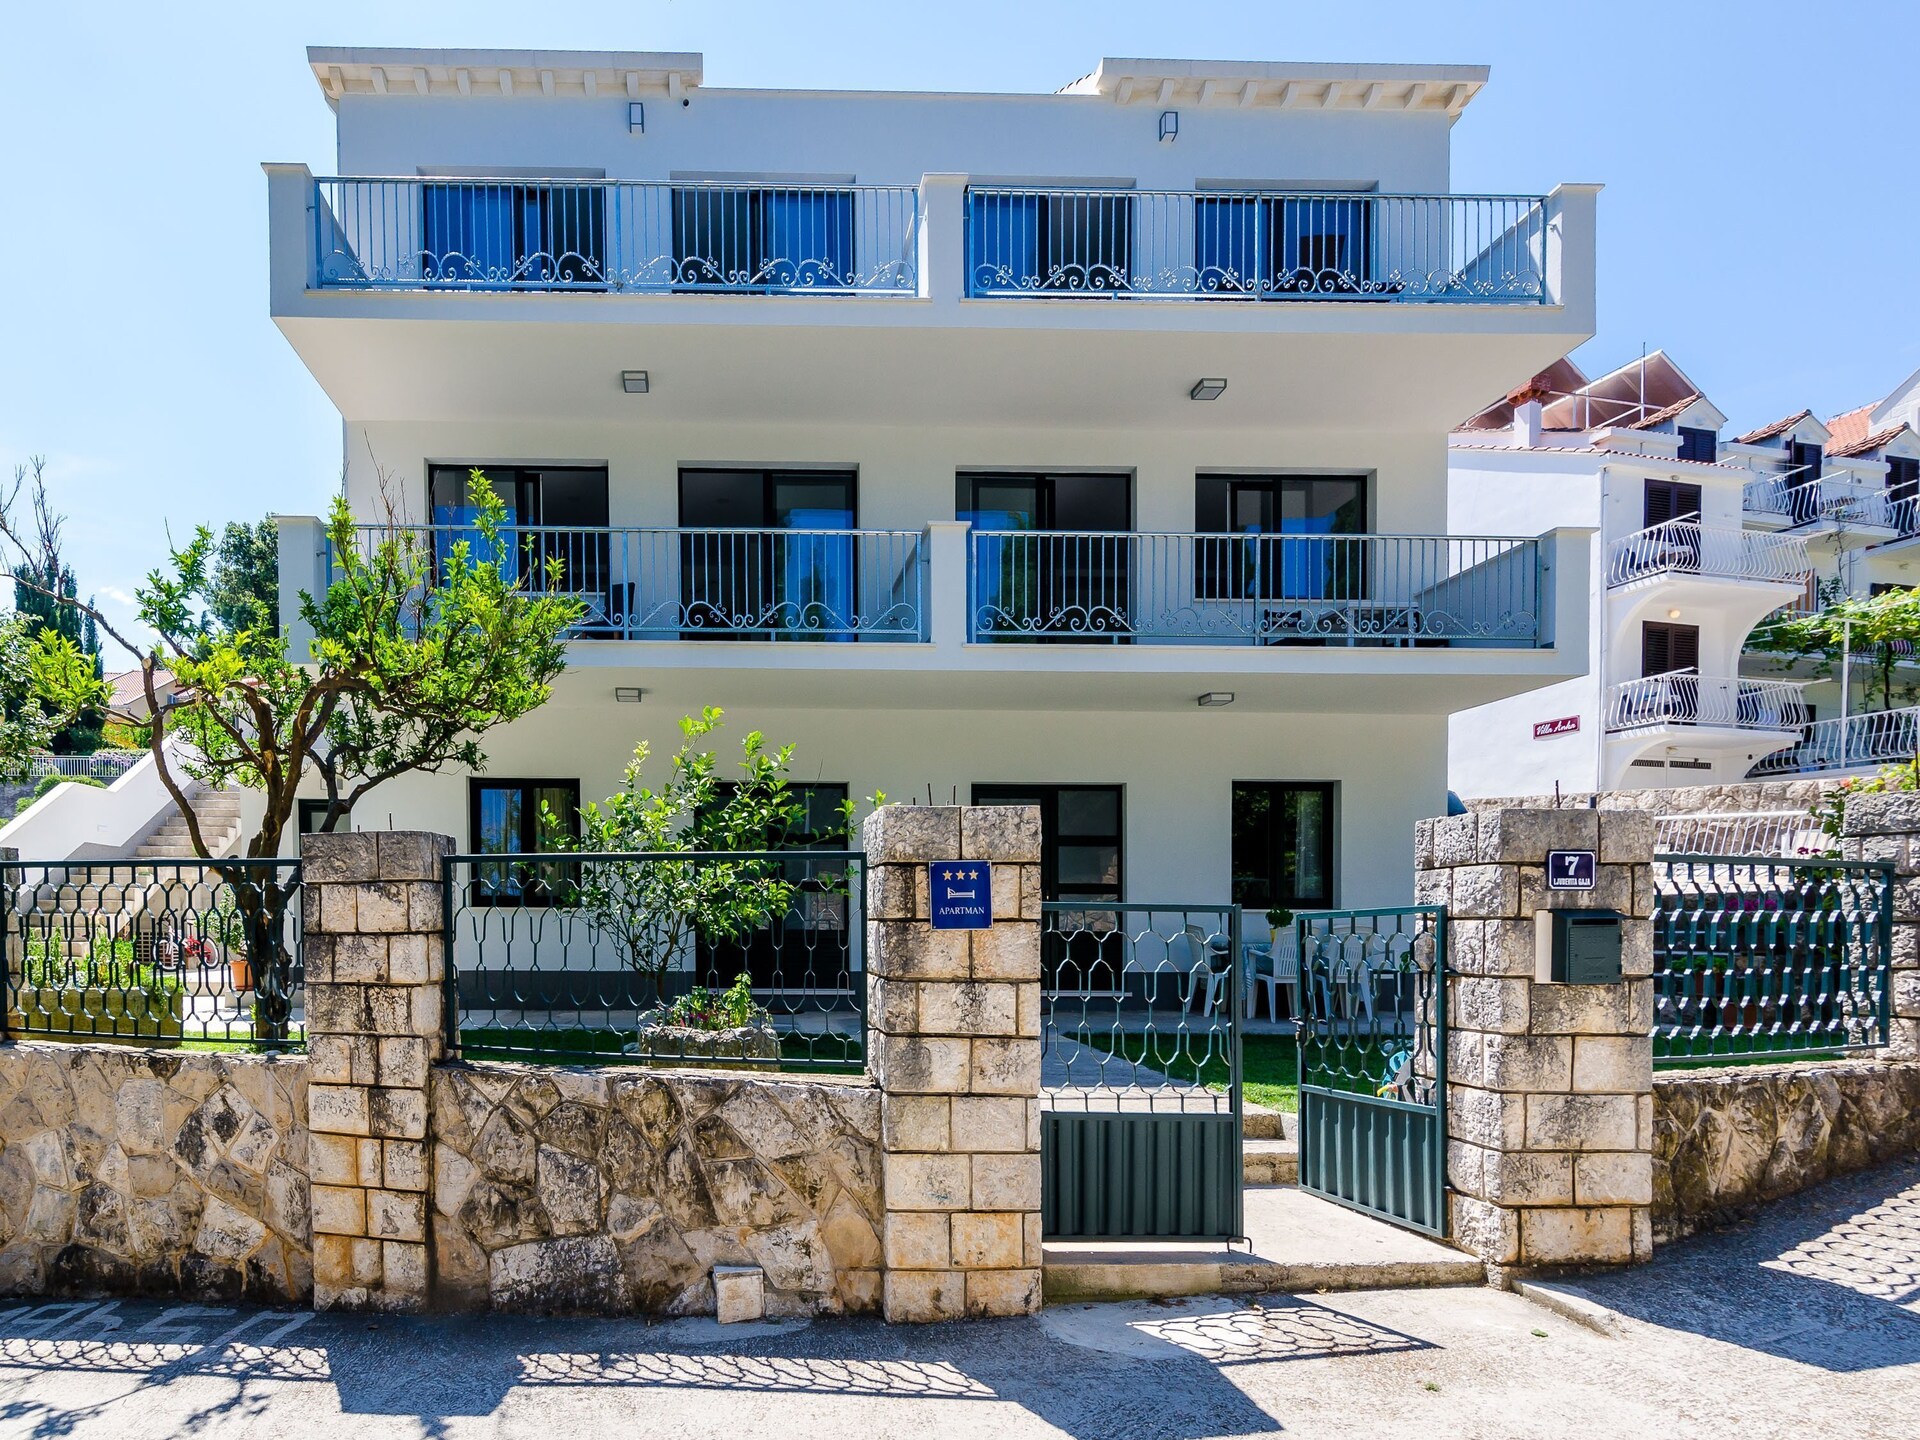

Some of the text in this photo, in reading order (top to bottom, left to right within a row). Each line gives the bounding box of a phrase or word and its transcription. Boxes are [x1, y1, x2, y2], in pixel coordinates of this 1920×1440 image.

[1536, 723, 1553, 735] Villa
[1564, 855, 1580, 876] 7
[1578, 877, 1591, 886] GAJA
[938, 906, 985, 915] APARTMAN
